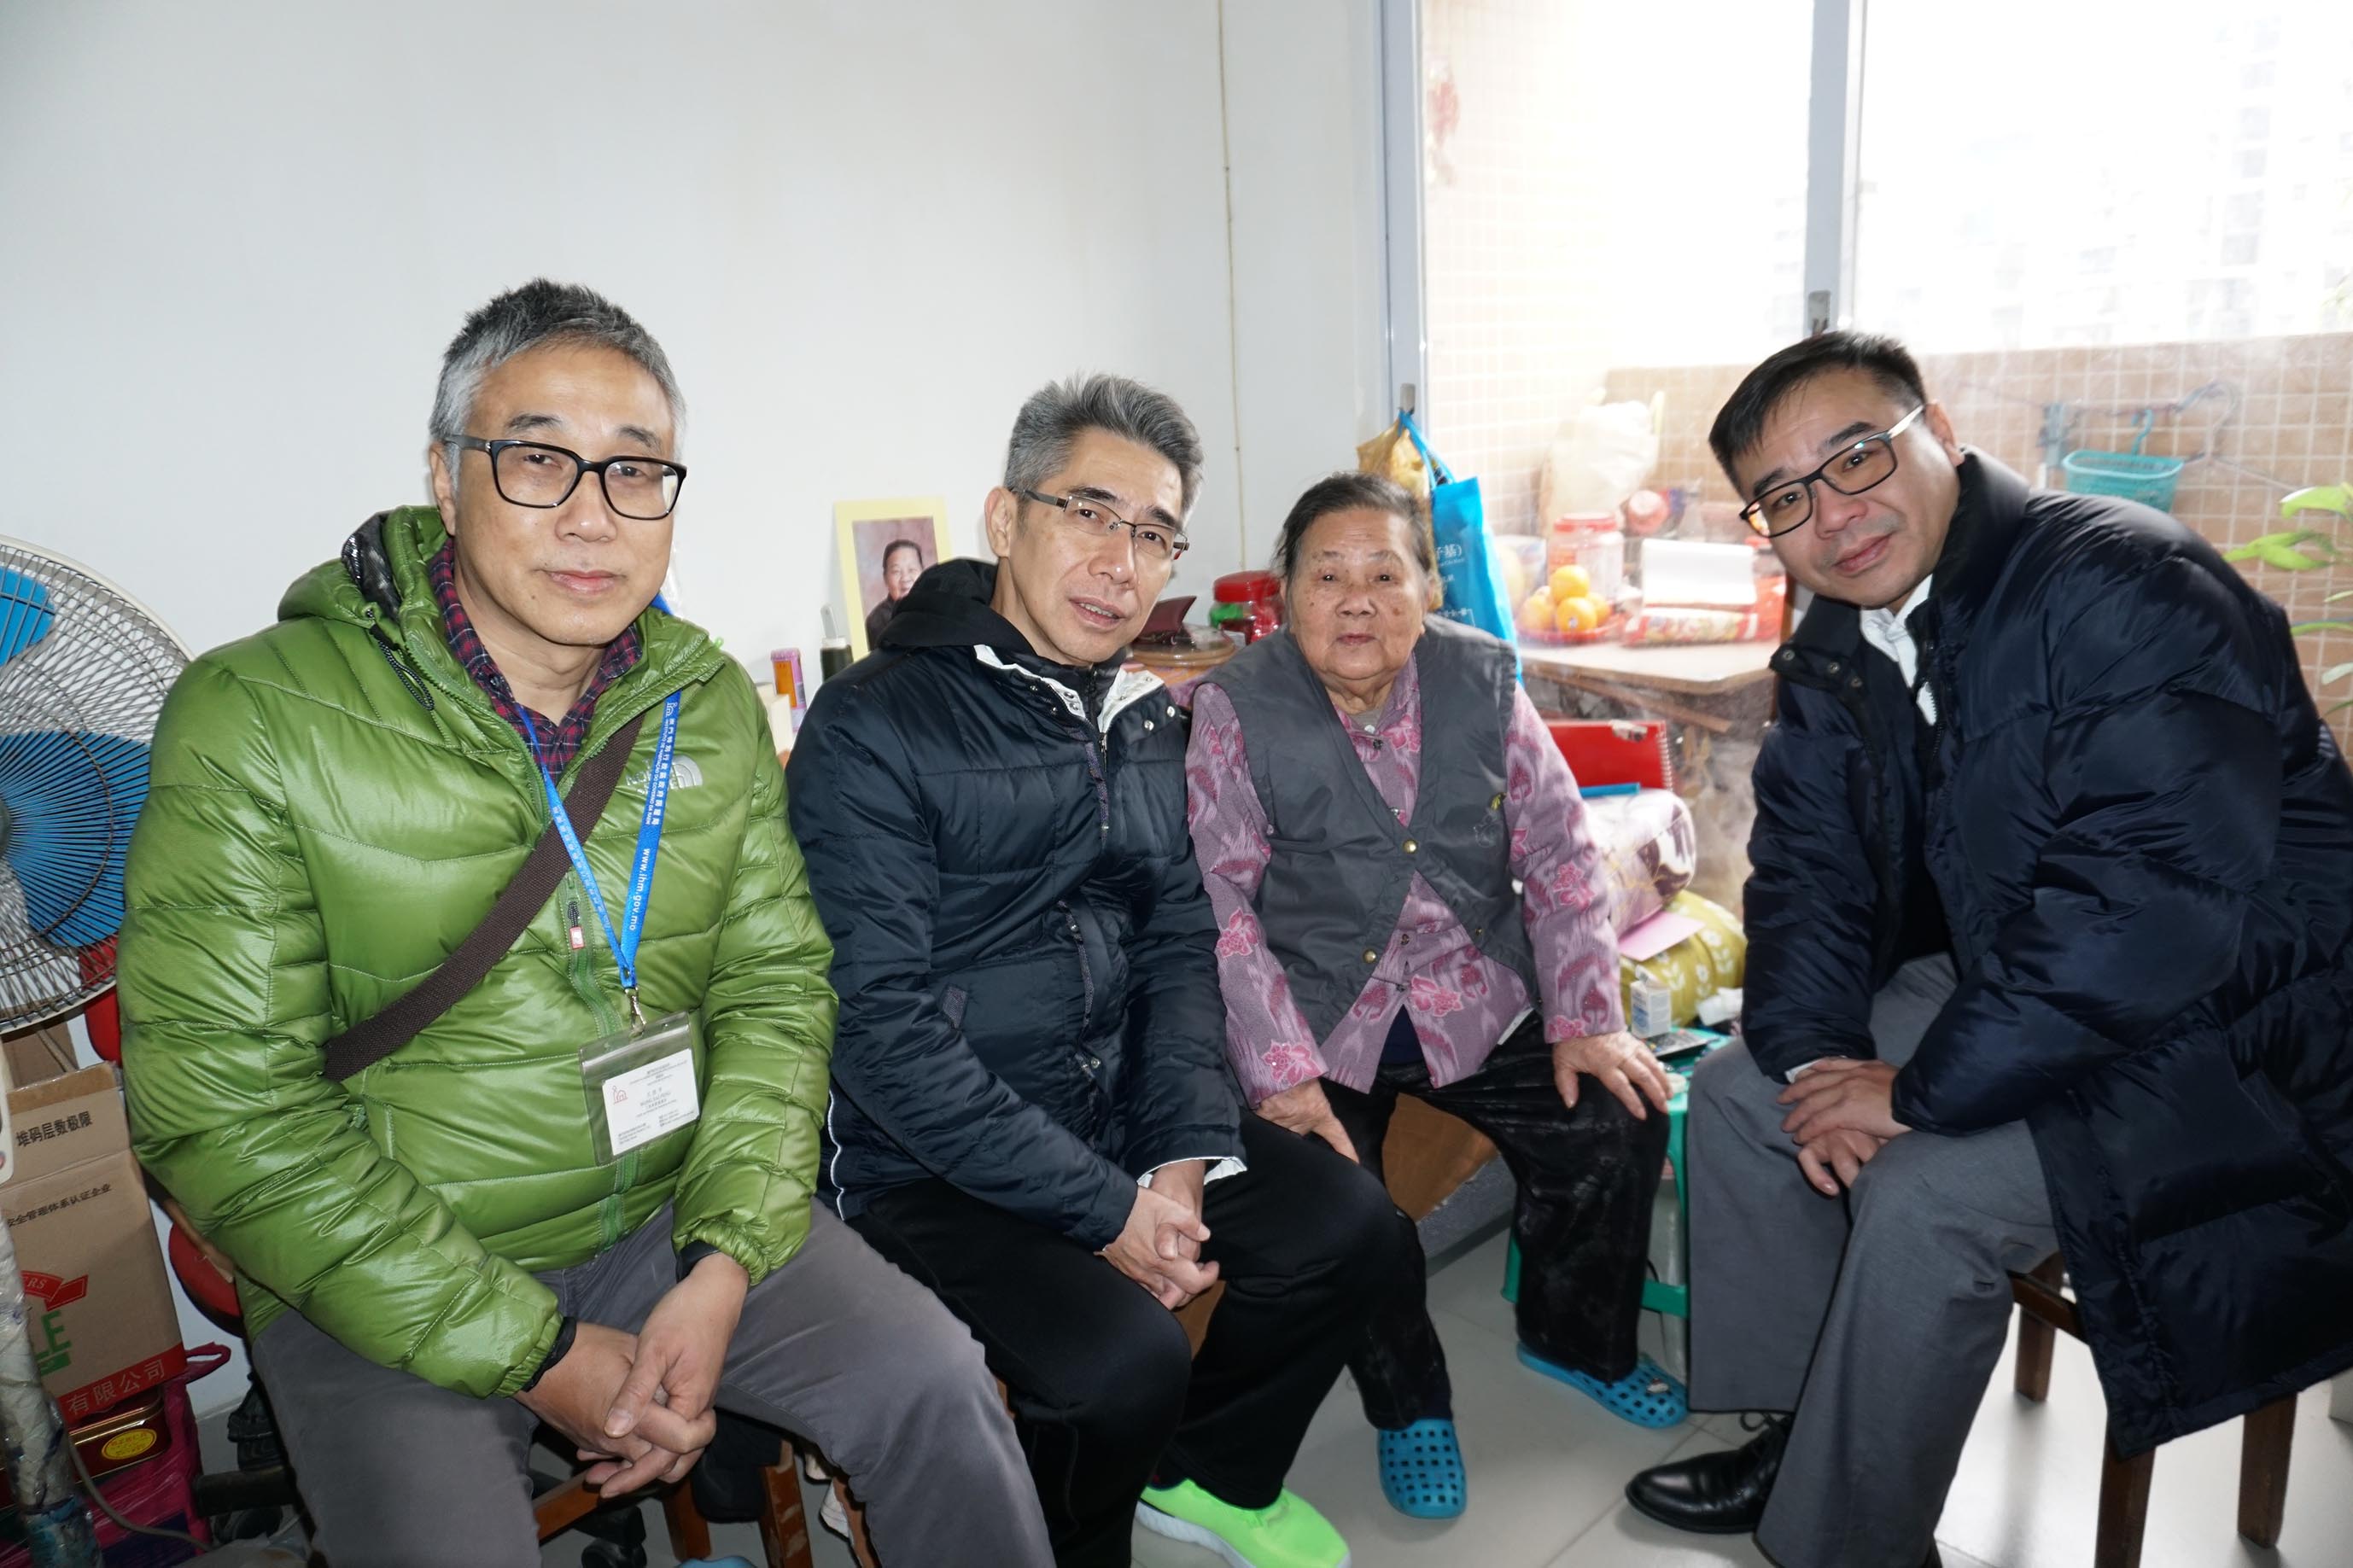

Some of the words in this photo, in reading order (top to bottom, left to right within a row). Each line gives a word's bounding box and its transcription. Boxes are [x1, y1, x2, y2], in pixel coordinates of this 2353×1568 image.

[629, 848, 650, 930] www.ihm.gov.mo
[15, 1111, 93, 1147] 堆码层数极限
[24, 1276, 47, 1289] RS
[35, 1309, 72, 1359] E
[67, 1359, 165, 1414] 有限公司
